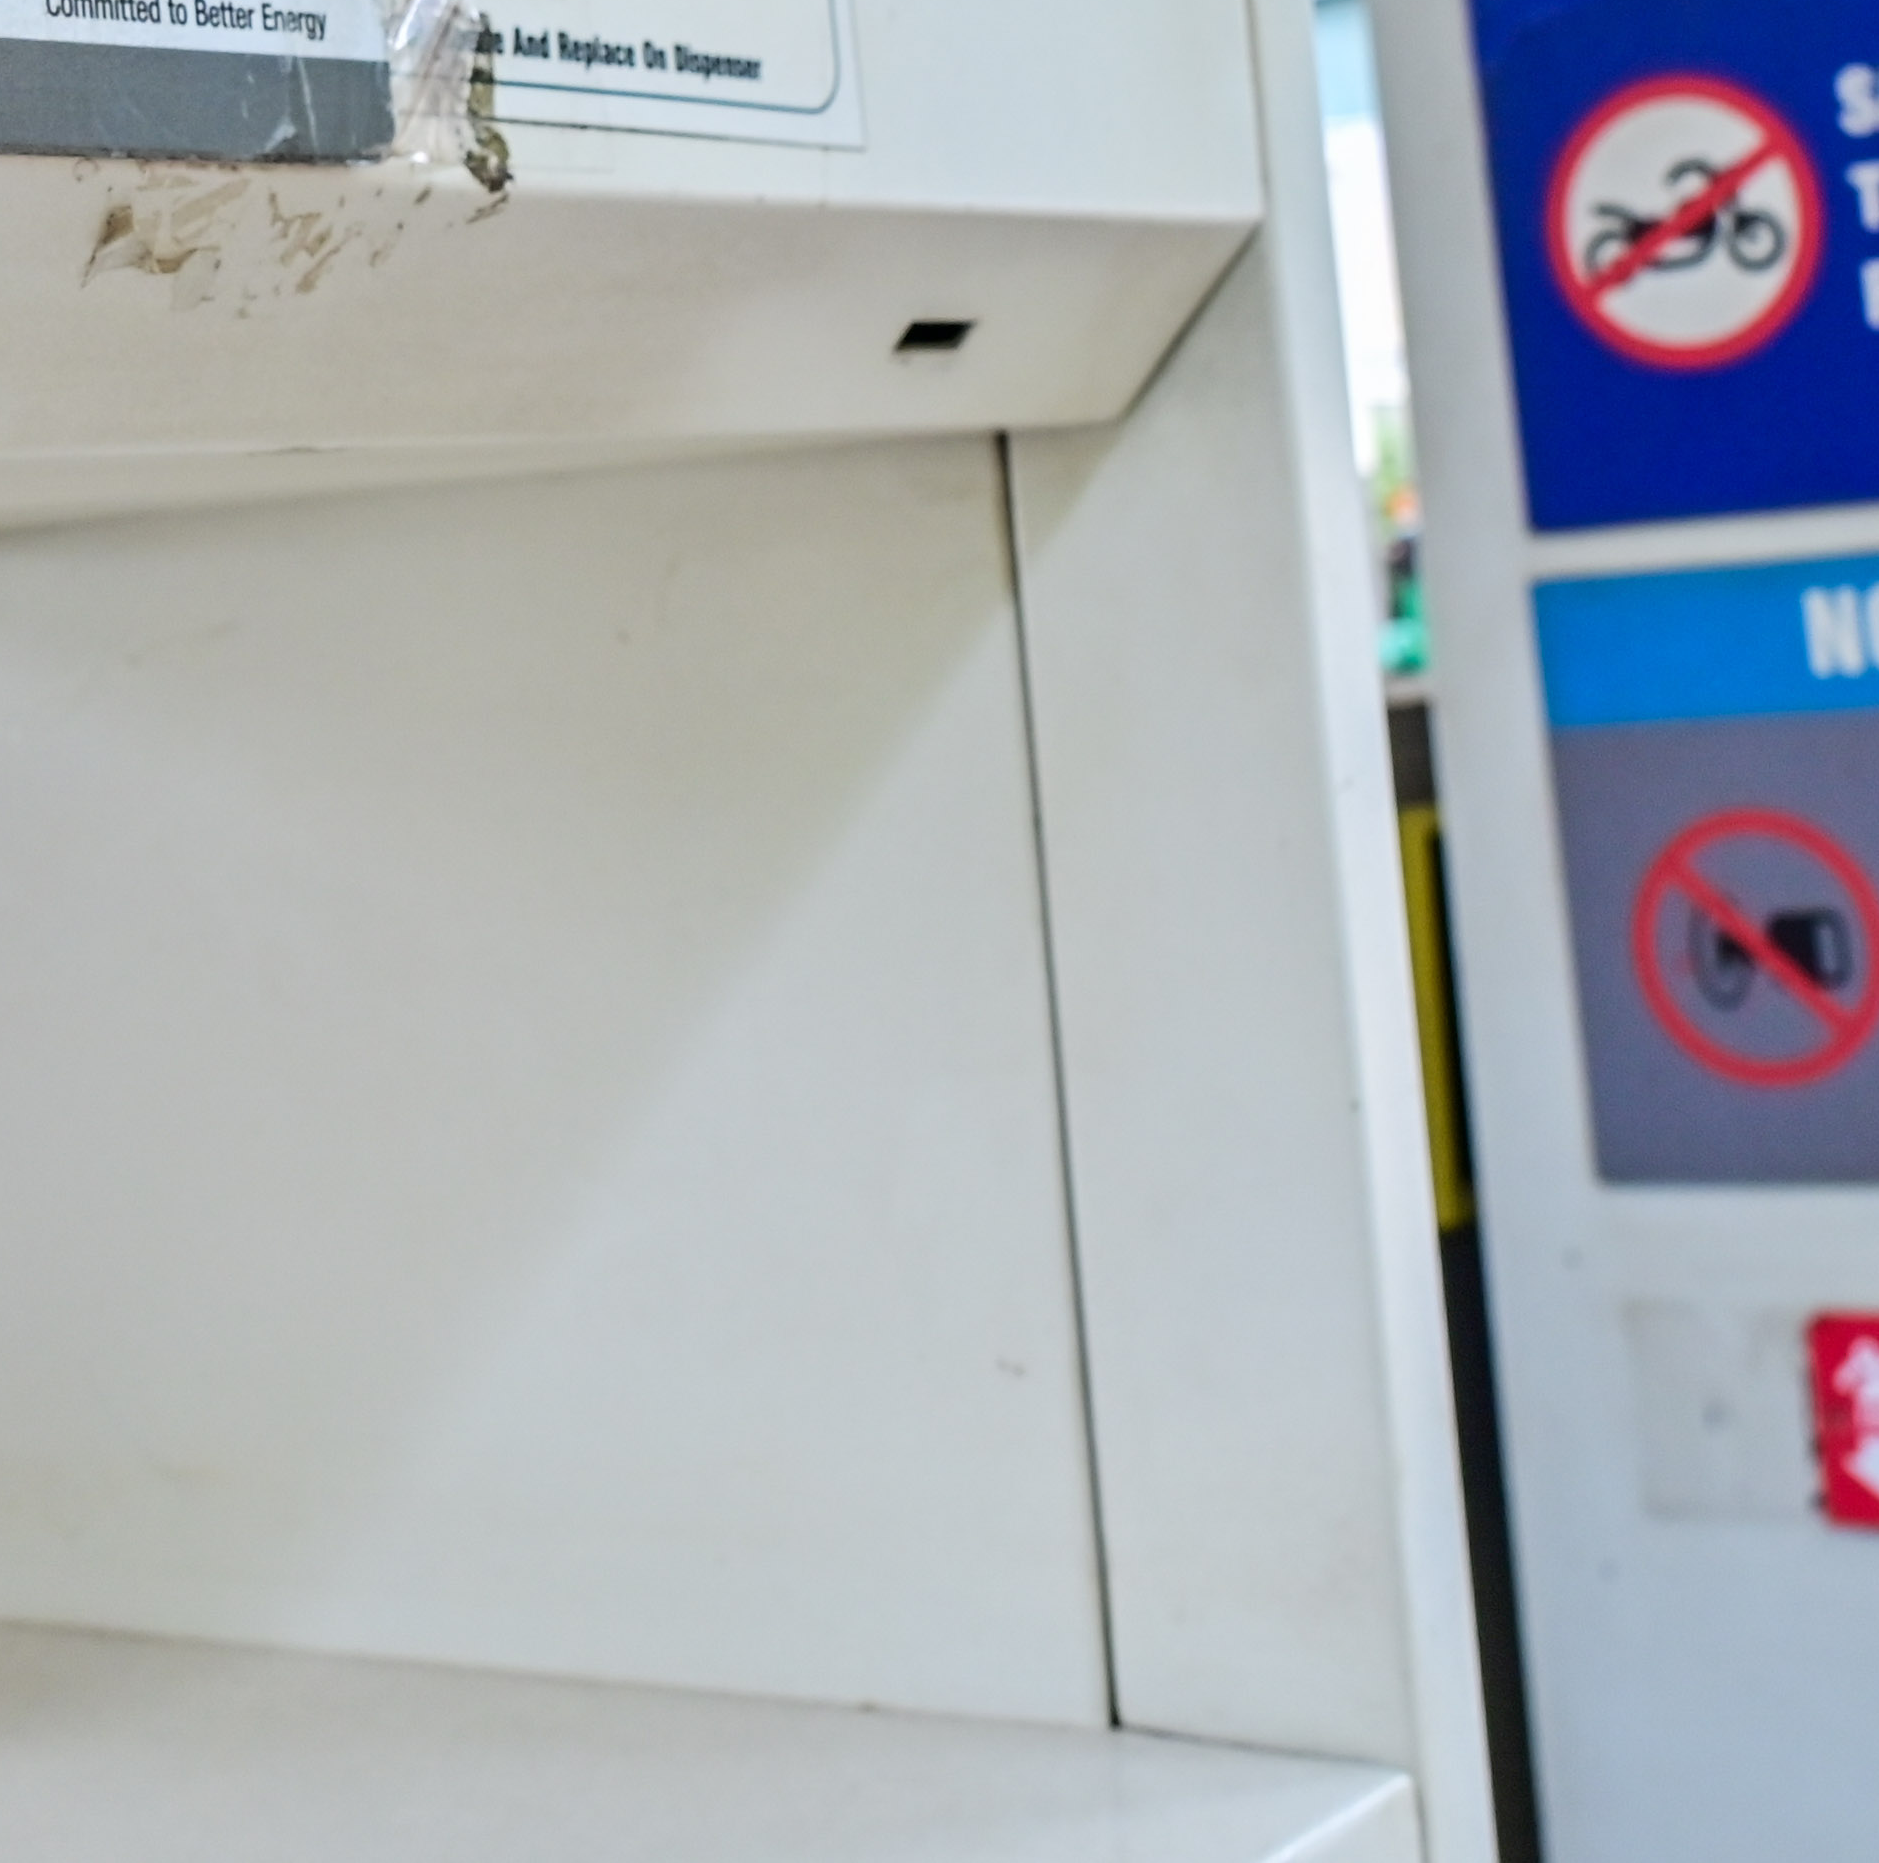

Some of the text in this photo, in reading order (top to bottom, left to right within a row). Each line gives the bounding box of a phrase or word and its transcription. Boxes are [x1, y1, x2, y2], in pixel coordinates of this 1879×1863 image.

[262, 3, 326, 41] Energy
[513, 26, 551, 60] And
[557, 31, 635, 71] Replace
[643, 40, 668, 71] On
[674, 43, 762, 84] Dispenser
